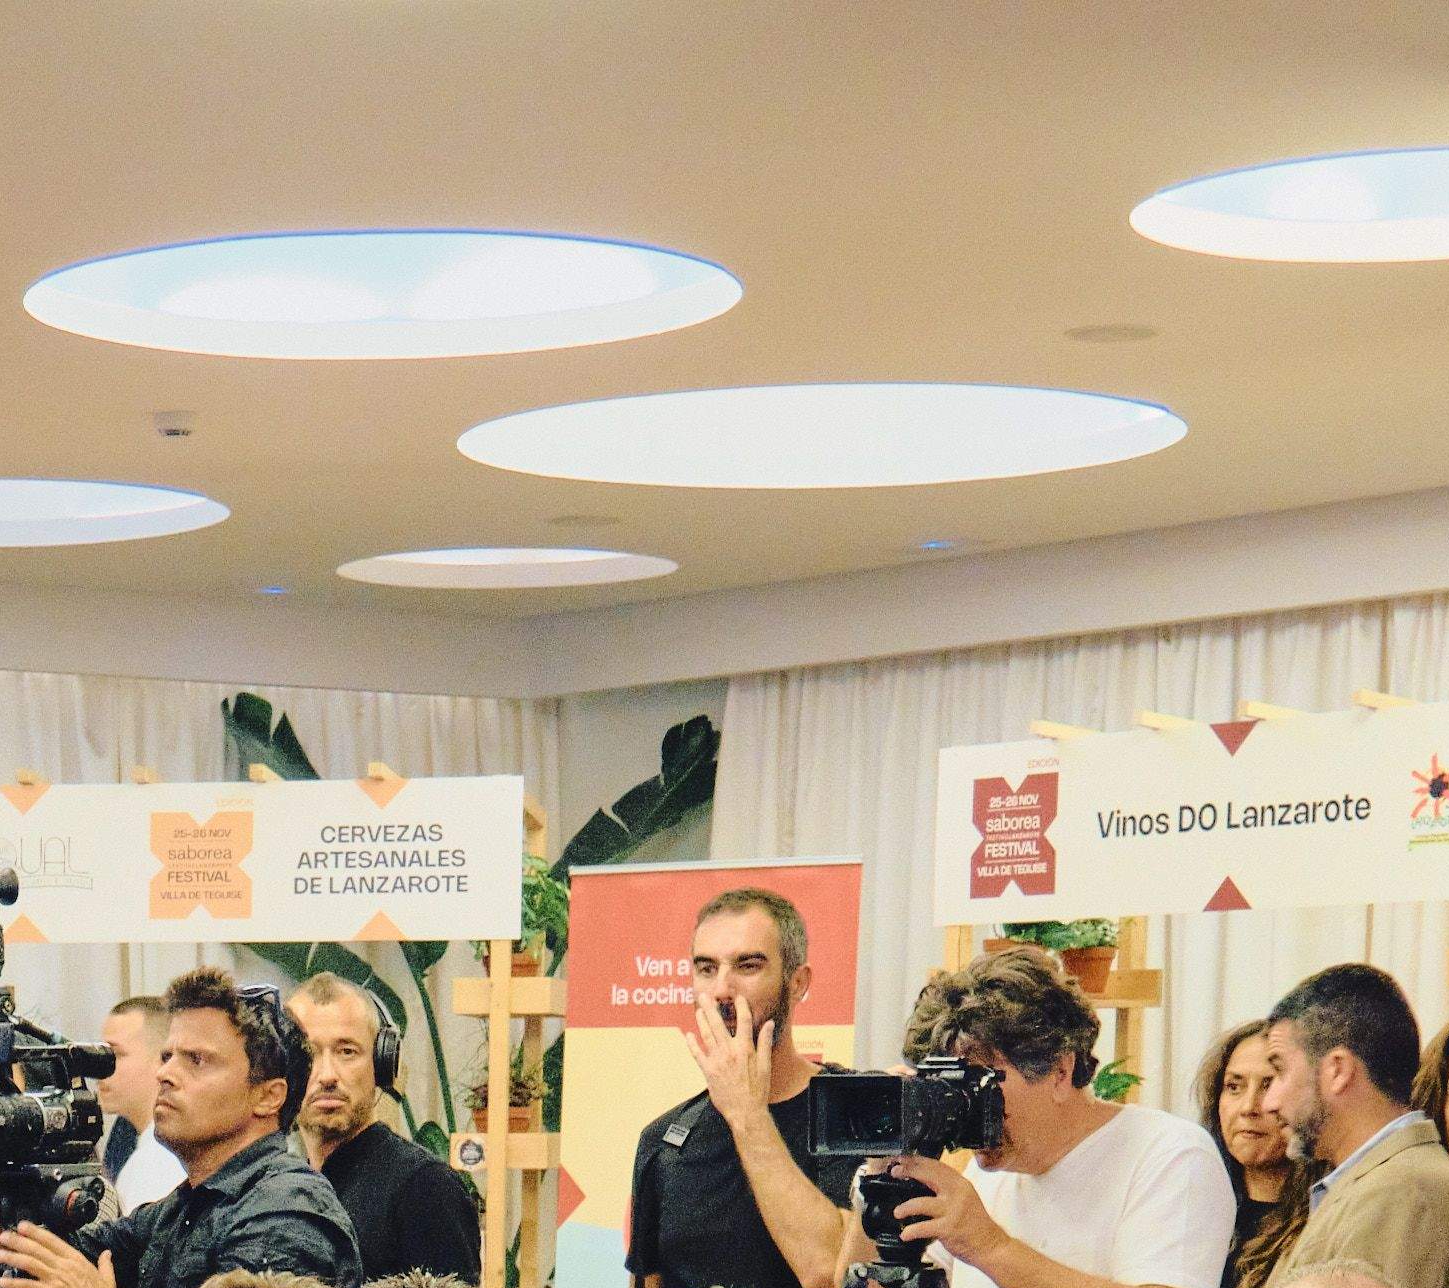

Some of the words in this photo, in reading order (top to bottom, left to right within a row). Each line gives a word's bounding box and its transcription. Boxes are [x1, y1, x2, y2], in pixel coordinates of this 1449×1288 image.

[1019, 794, 1039, 806] NOV
[986, 814, 1040, 832] saborea
[1098, 809, 1169, 838] Vinos
[1179, 803, 1217, 832] DO
[1227, 794, 1371, 829] Lanzarote
[209, 829, 232, 838] NOV
[320, 824, 443, 844] CERVEZAS
[168, 844, 232, 859] saborea
[985, 840, 1039, 858] FESTIVAL
[297, 850, 466, 869] ARTESANALES
[168, 870, 232, 882] FESTIVAL
[977, 866, 1001, 877] VILLA
[294, 877, 322, 894] DE
[329, 875, 468, 894] LANZAROTE
[160, 890, 186, 900] VILLA
[189, 890, 201, 900] DE
[635, 956, 672, 977] Ven
[677, 960, 690, 976] a
[611, 984, 628, 1005] la
